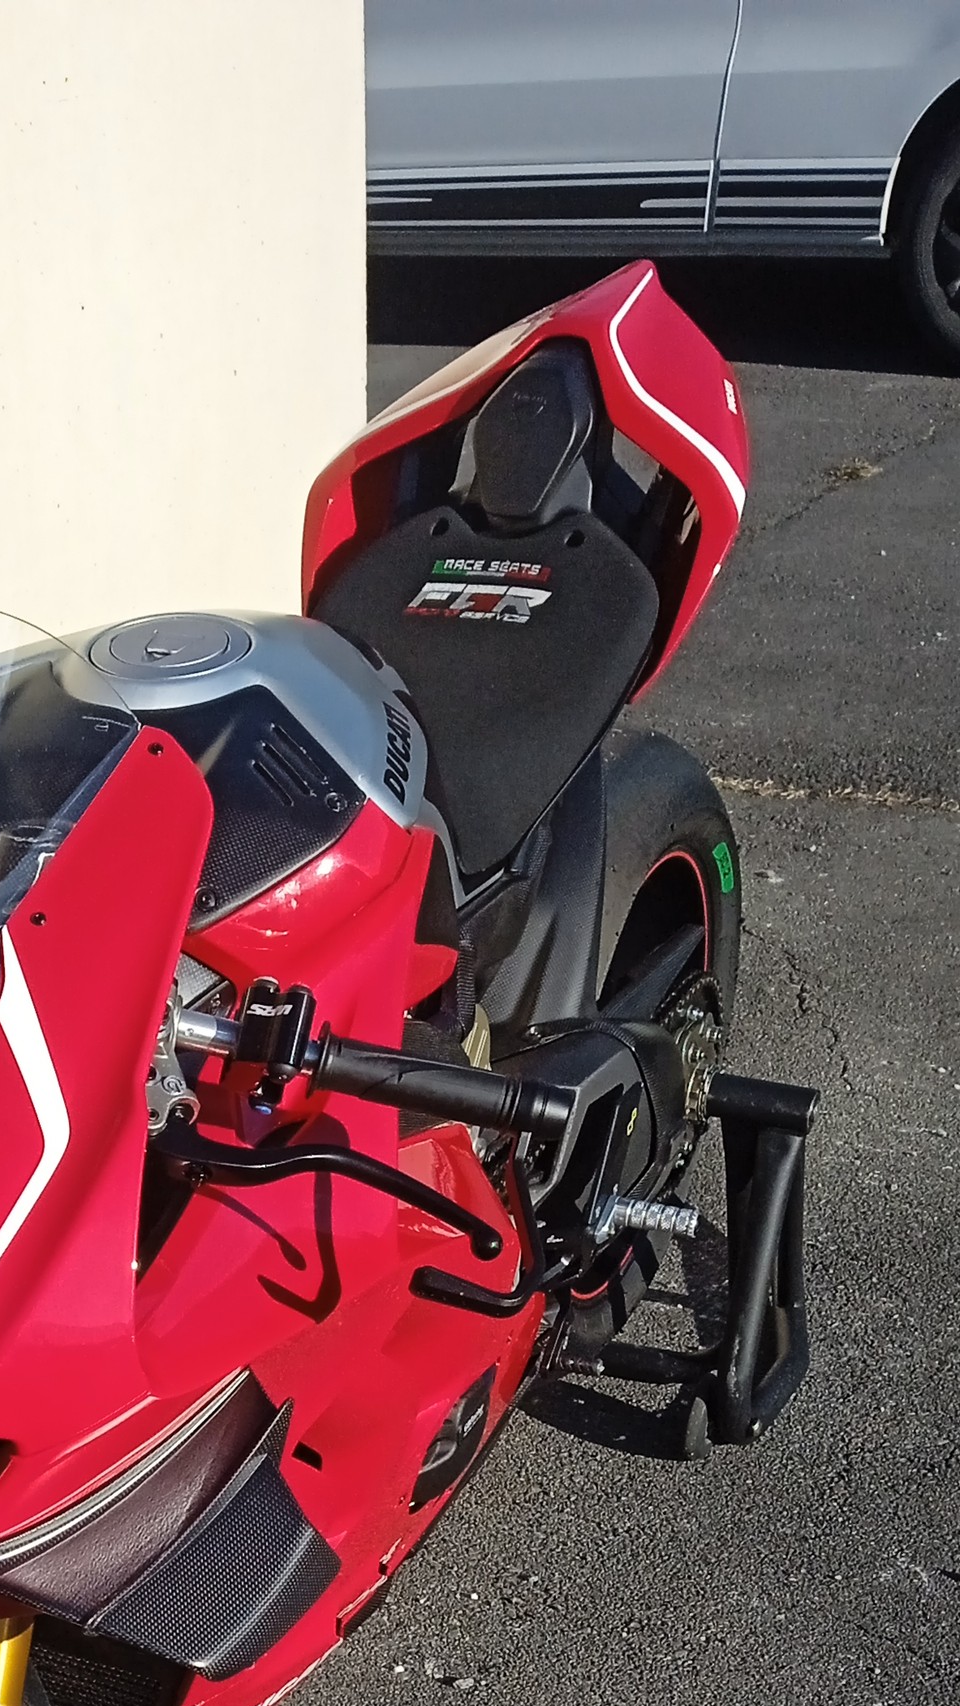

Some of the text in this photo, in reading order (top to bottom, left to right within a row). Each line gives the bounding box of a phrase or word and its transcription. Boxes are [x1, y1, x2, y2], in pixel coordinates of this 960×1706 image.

[443, 559, 542, 576] RACE SEATS
[382, 701, 412, 806] DUCATI
